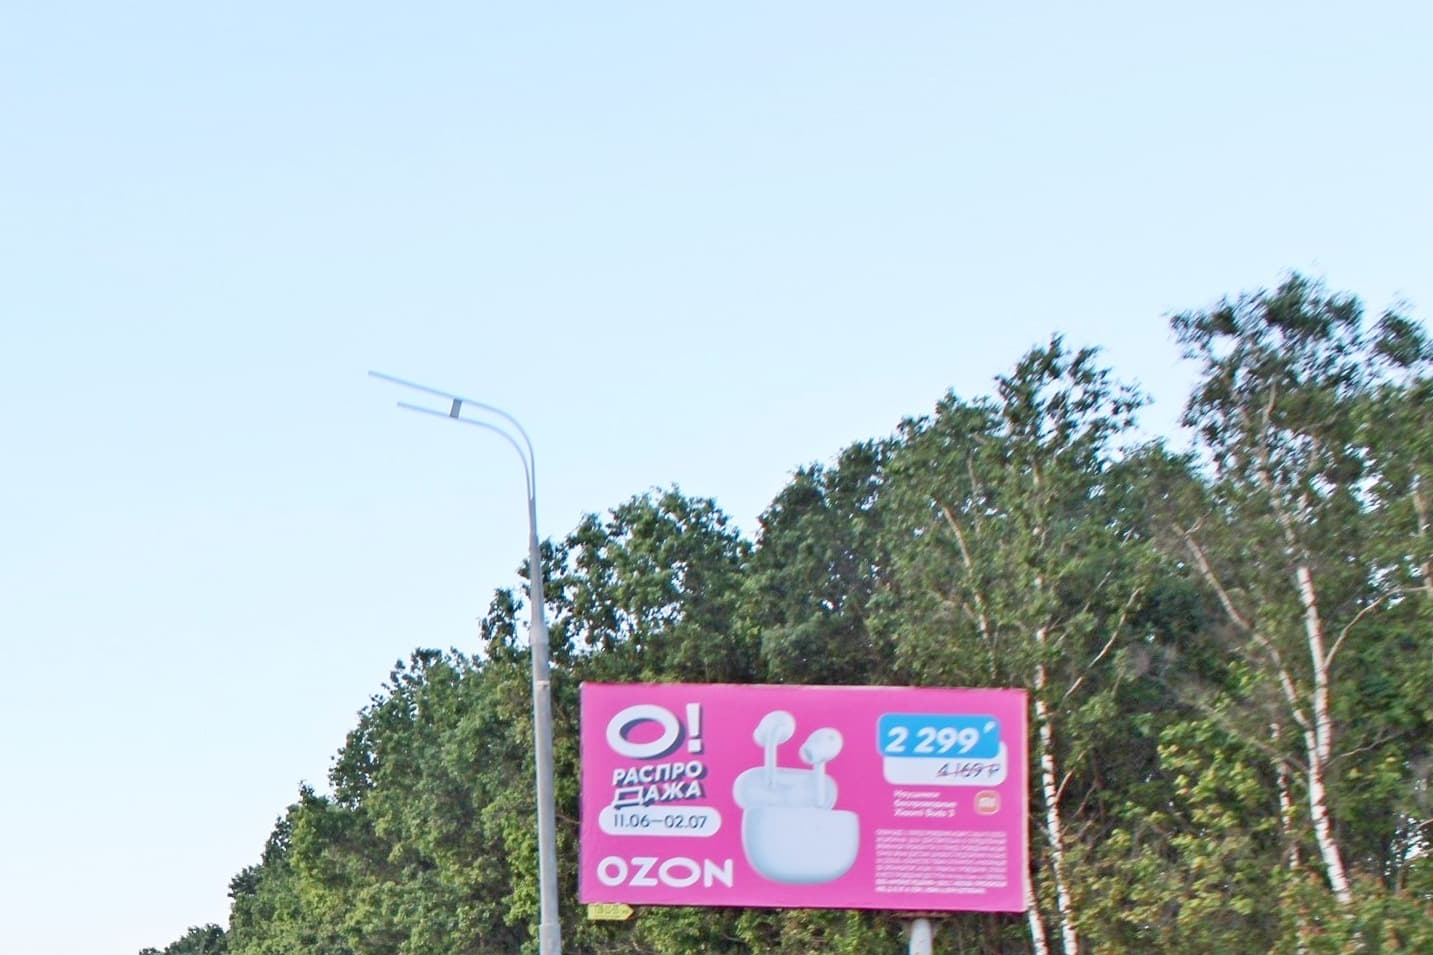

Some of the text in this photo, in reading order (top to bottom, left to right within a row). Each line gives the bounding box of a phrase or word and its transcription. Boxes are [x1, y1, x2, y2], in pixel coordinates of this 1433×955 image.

[885, 726, 909, 753] 2
[913, 726, 980, 754] 299
[612, 760, 706, 786] РАСПРО
[597, 855, 734, 889] OZON
